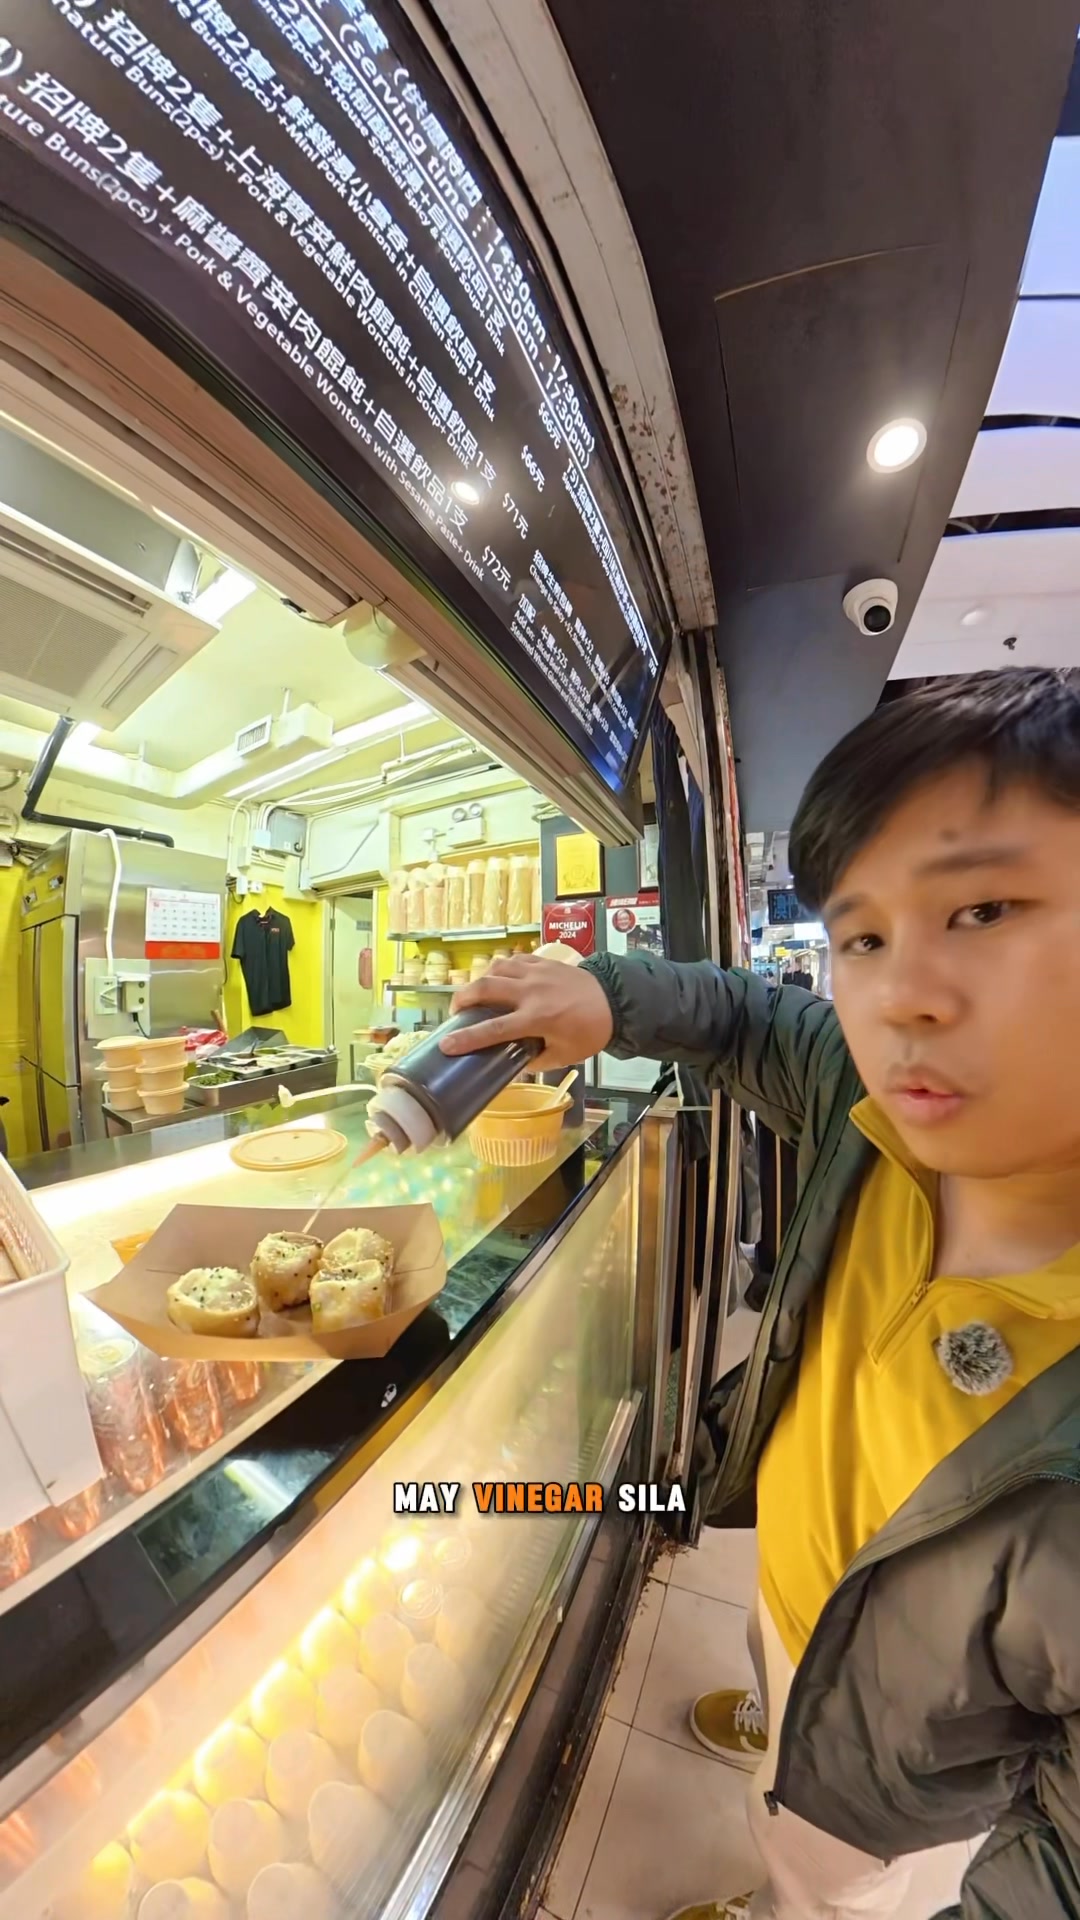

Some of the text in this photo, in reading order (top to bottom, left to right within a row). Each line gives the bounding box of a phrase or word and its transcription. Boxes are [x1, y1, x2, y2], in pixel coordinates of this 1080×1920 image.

[125, 65, 225, 161] Buns(2pcs)
[237, 172, 276, 214] Pork
[274, 210, 288, 228] &
[289, 222, 357, 309] Vegetable
[355, 303, 407, 378] Wontons
[405, 373, 418, 394] in
[446, 432, 471, 471] Drink
[190, 18, 277, 113] Buns(2pcs)
[317, 161, 348, 199] Pork
[348, 194, 398, 264] Wontons
[396, 260, 409, 283] in
[407, 280, 446, 342] Chicken
[443, 338, 468, 377] Soup
[473, 385, 496, 423] Drink
[367, 135, 407, 191] Special
[404, 189, 432, 226] Spicy
[438, 237, 461, 273] Sour
[485, 317, 506, 358] Drink
[44, 131, 158, 224] Buns(2pcs)
[173, 232, 218, 276] Pork
[216, 270, 234, 292] &
[235, 283, 315, 379] Vegetable
[315, 371, 374, 446] Wontons
[372, 440, 399, 476] with
[397, 470, 436, 521] Sesame
[462, 549, 486, 582] Drink
[428, 155, 469, 222] time
[485, 242, 538, 361] 14:30pm
[546, 372, 591, 469] 17:30pm)
[552, 354, 595, 452] 17:30pm)
[502, 492, 530, 540] $71元
[520, 444, 546, 493] $66元
[481, 544, 512, 592] $72元
[549, 921, 588, 930] MICHELIN
[559, 931, 577, 939] 2024
